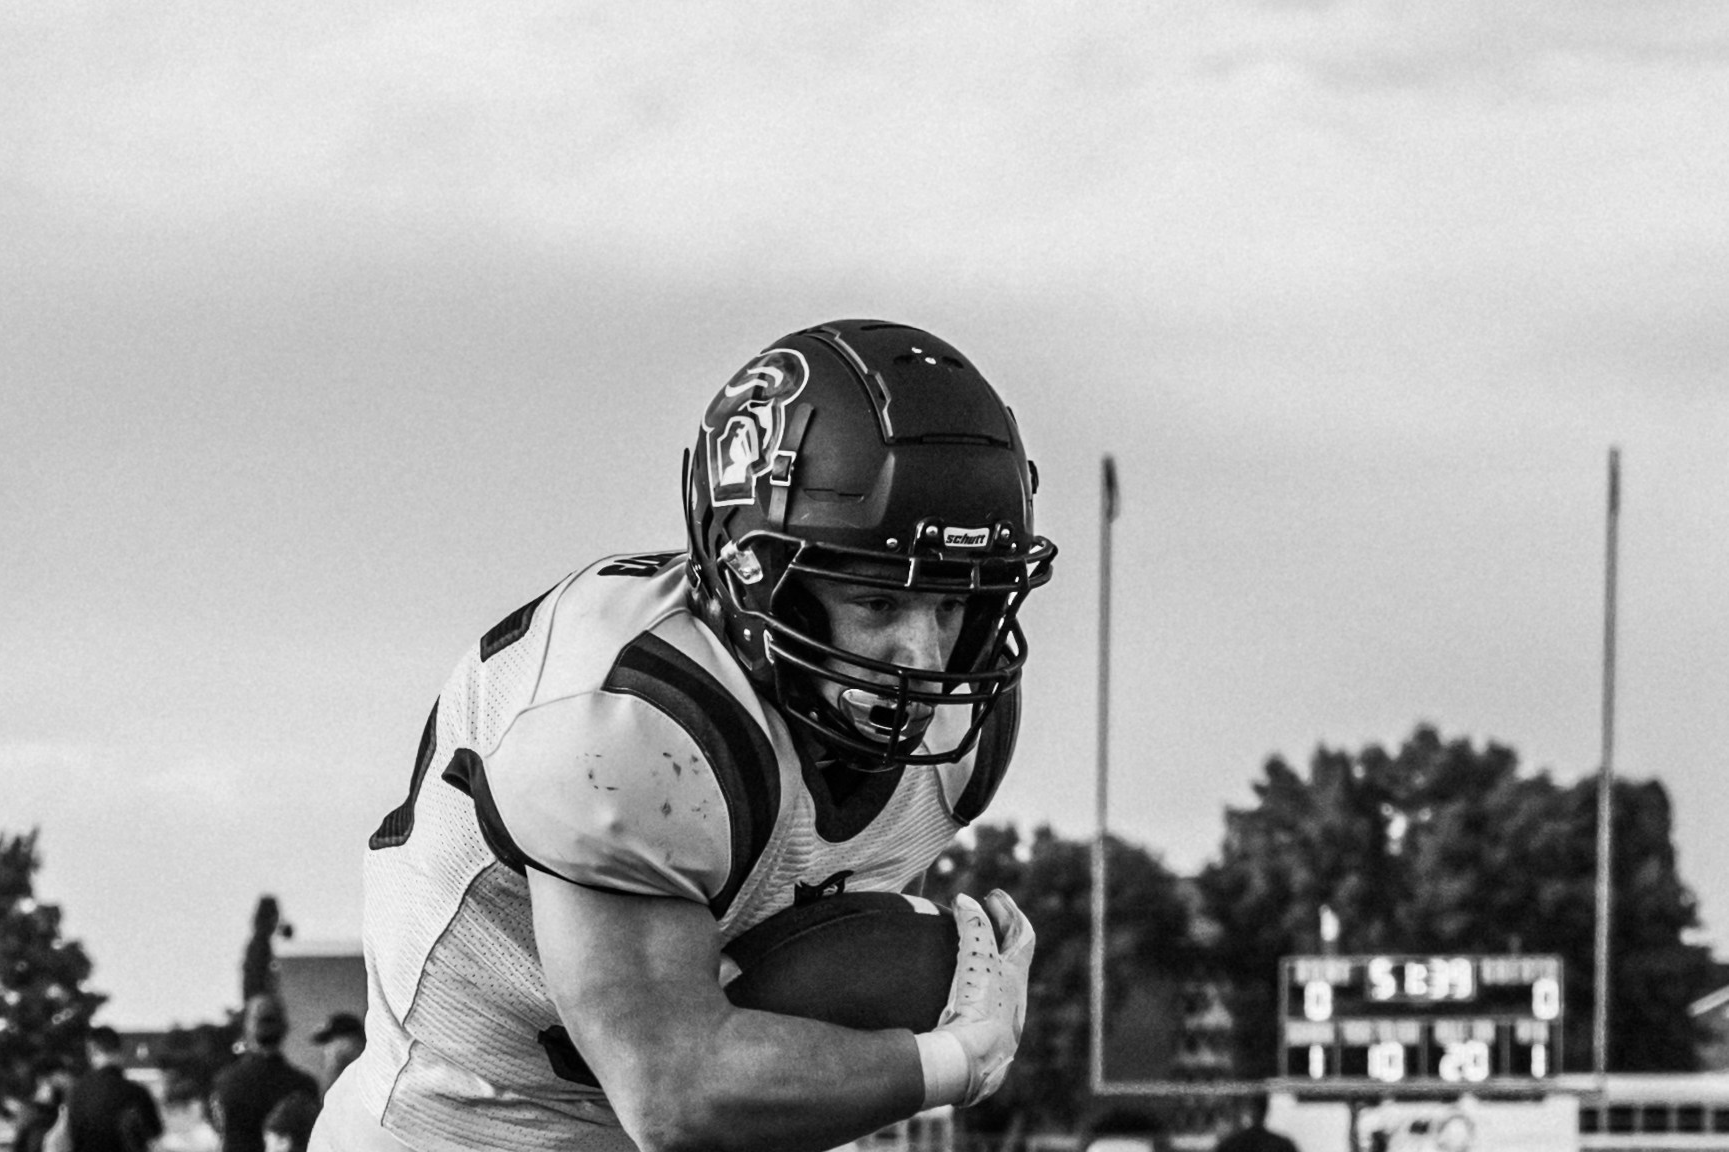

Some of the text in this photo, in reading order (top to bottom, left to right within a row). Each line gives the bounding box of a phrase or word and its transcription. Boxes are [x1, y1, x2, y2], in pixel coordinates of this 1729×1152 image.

[945, 533, 986, 545] schutt
[1304, 981, 1333, 1022] 0
[1532, 978, 1559, 1020] 0
